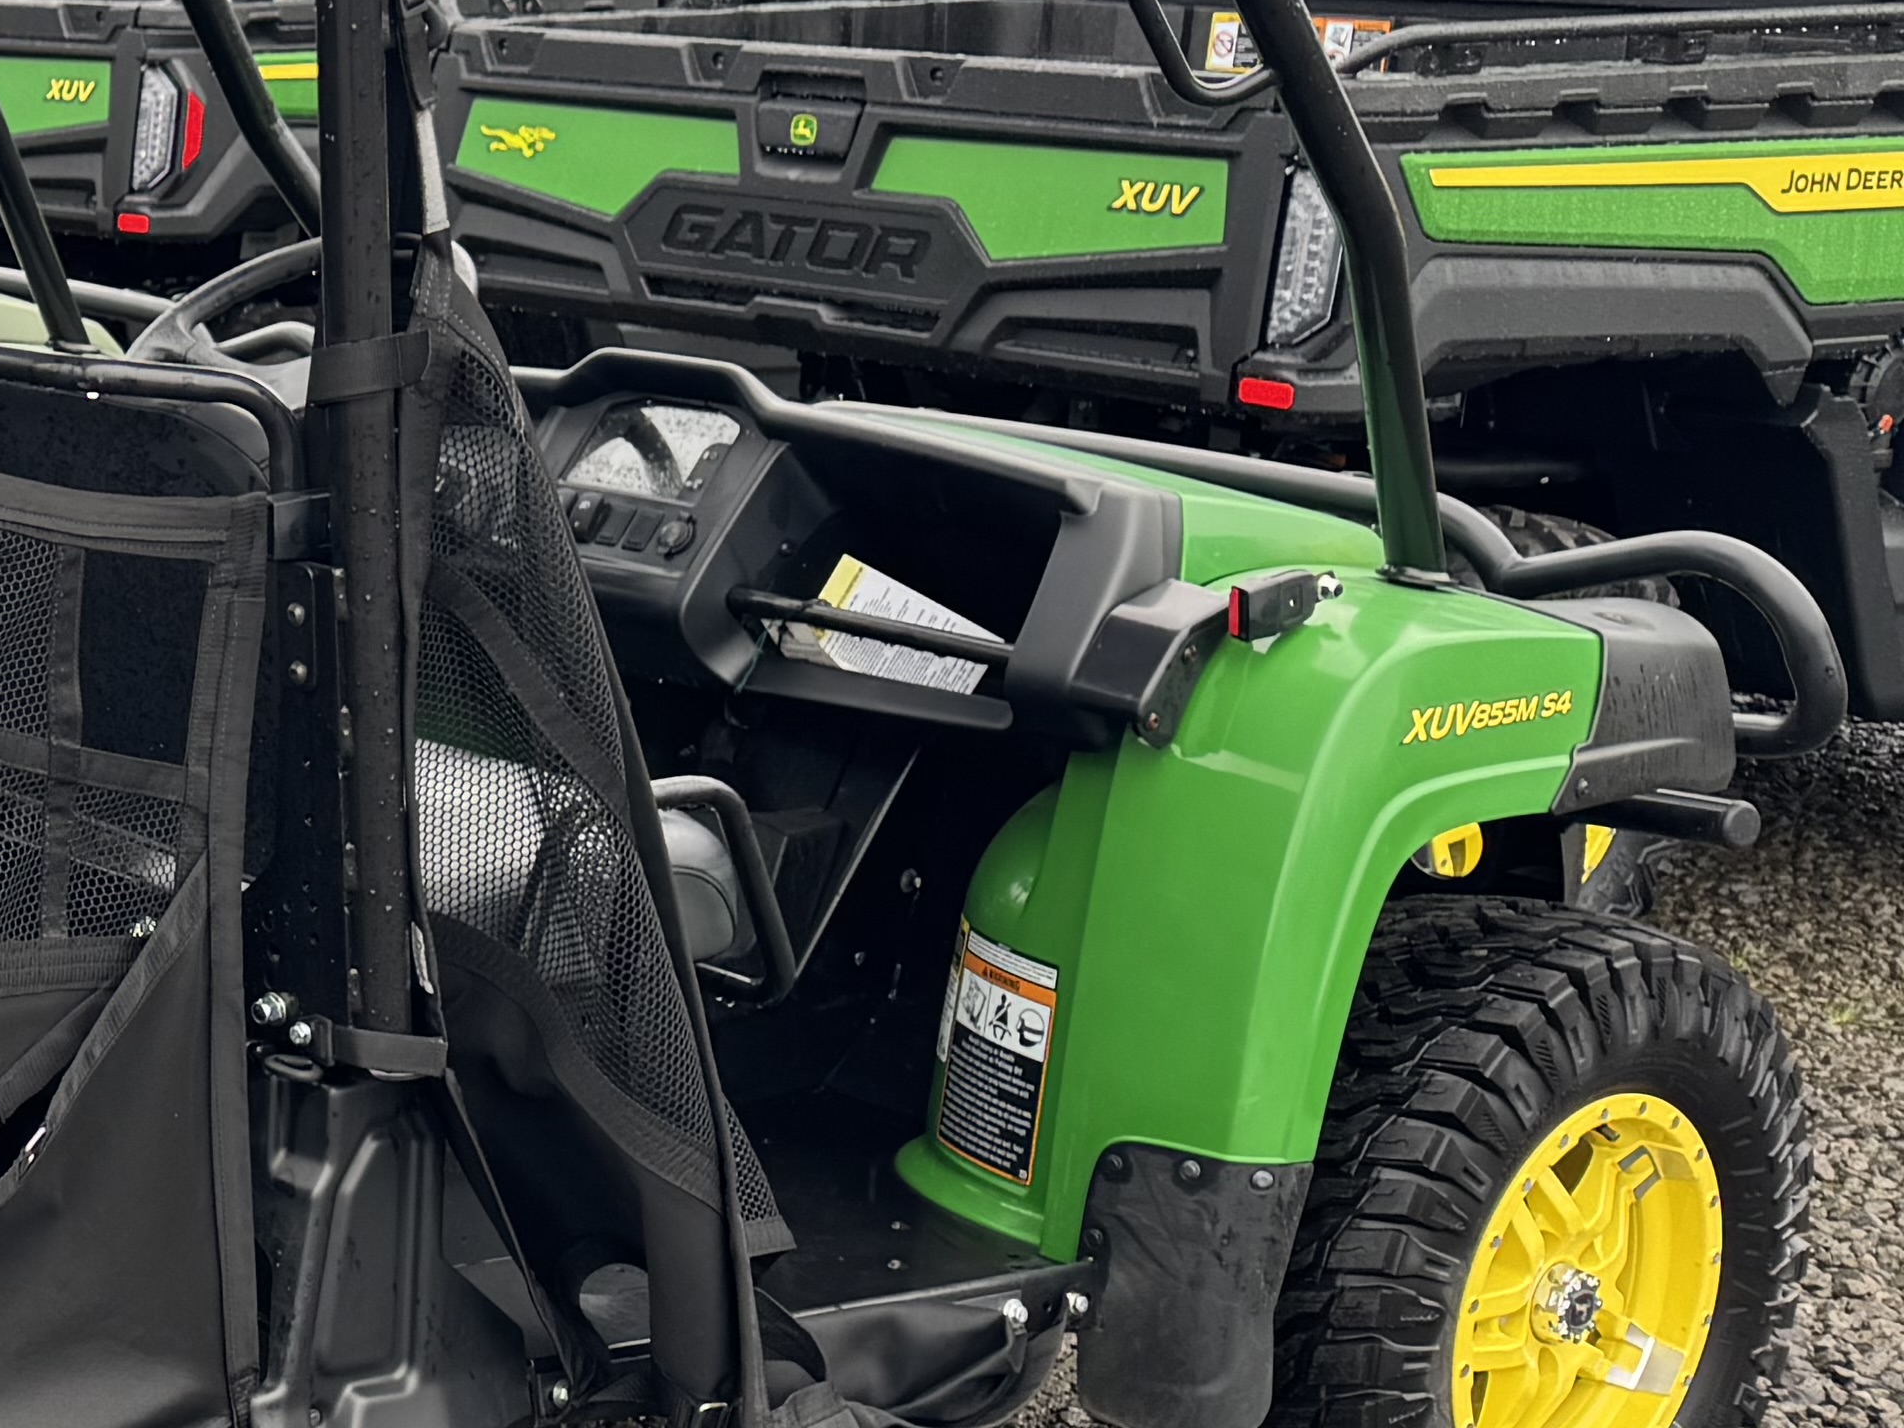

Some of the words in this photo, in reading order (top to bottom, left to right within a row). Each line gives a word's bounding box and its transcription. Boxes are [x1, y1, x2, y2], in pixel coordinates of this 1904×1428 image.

[46, 78, 95, 104] XUV
[1109, 179, 1202, 215] XUV
[1781, 169, 1841, 194] JOHN
[1846, 167, 1904, 191] DEER
[660, 204, 933, 281] GATOR
[1401, 695, 1539, 744] XUV855M
[1541, 690, 1572, 718] S4
